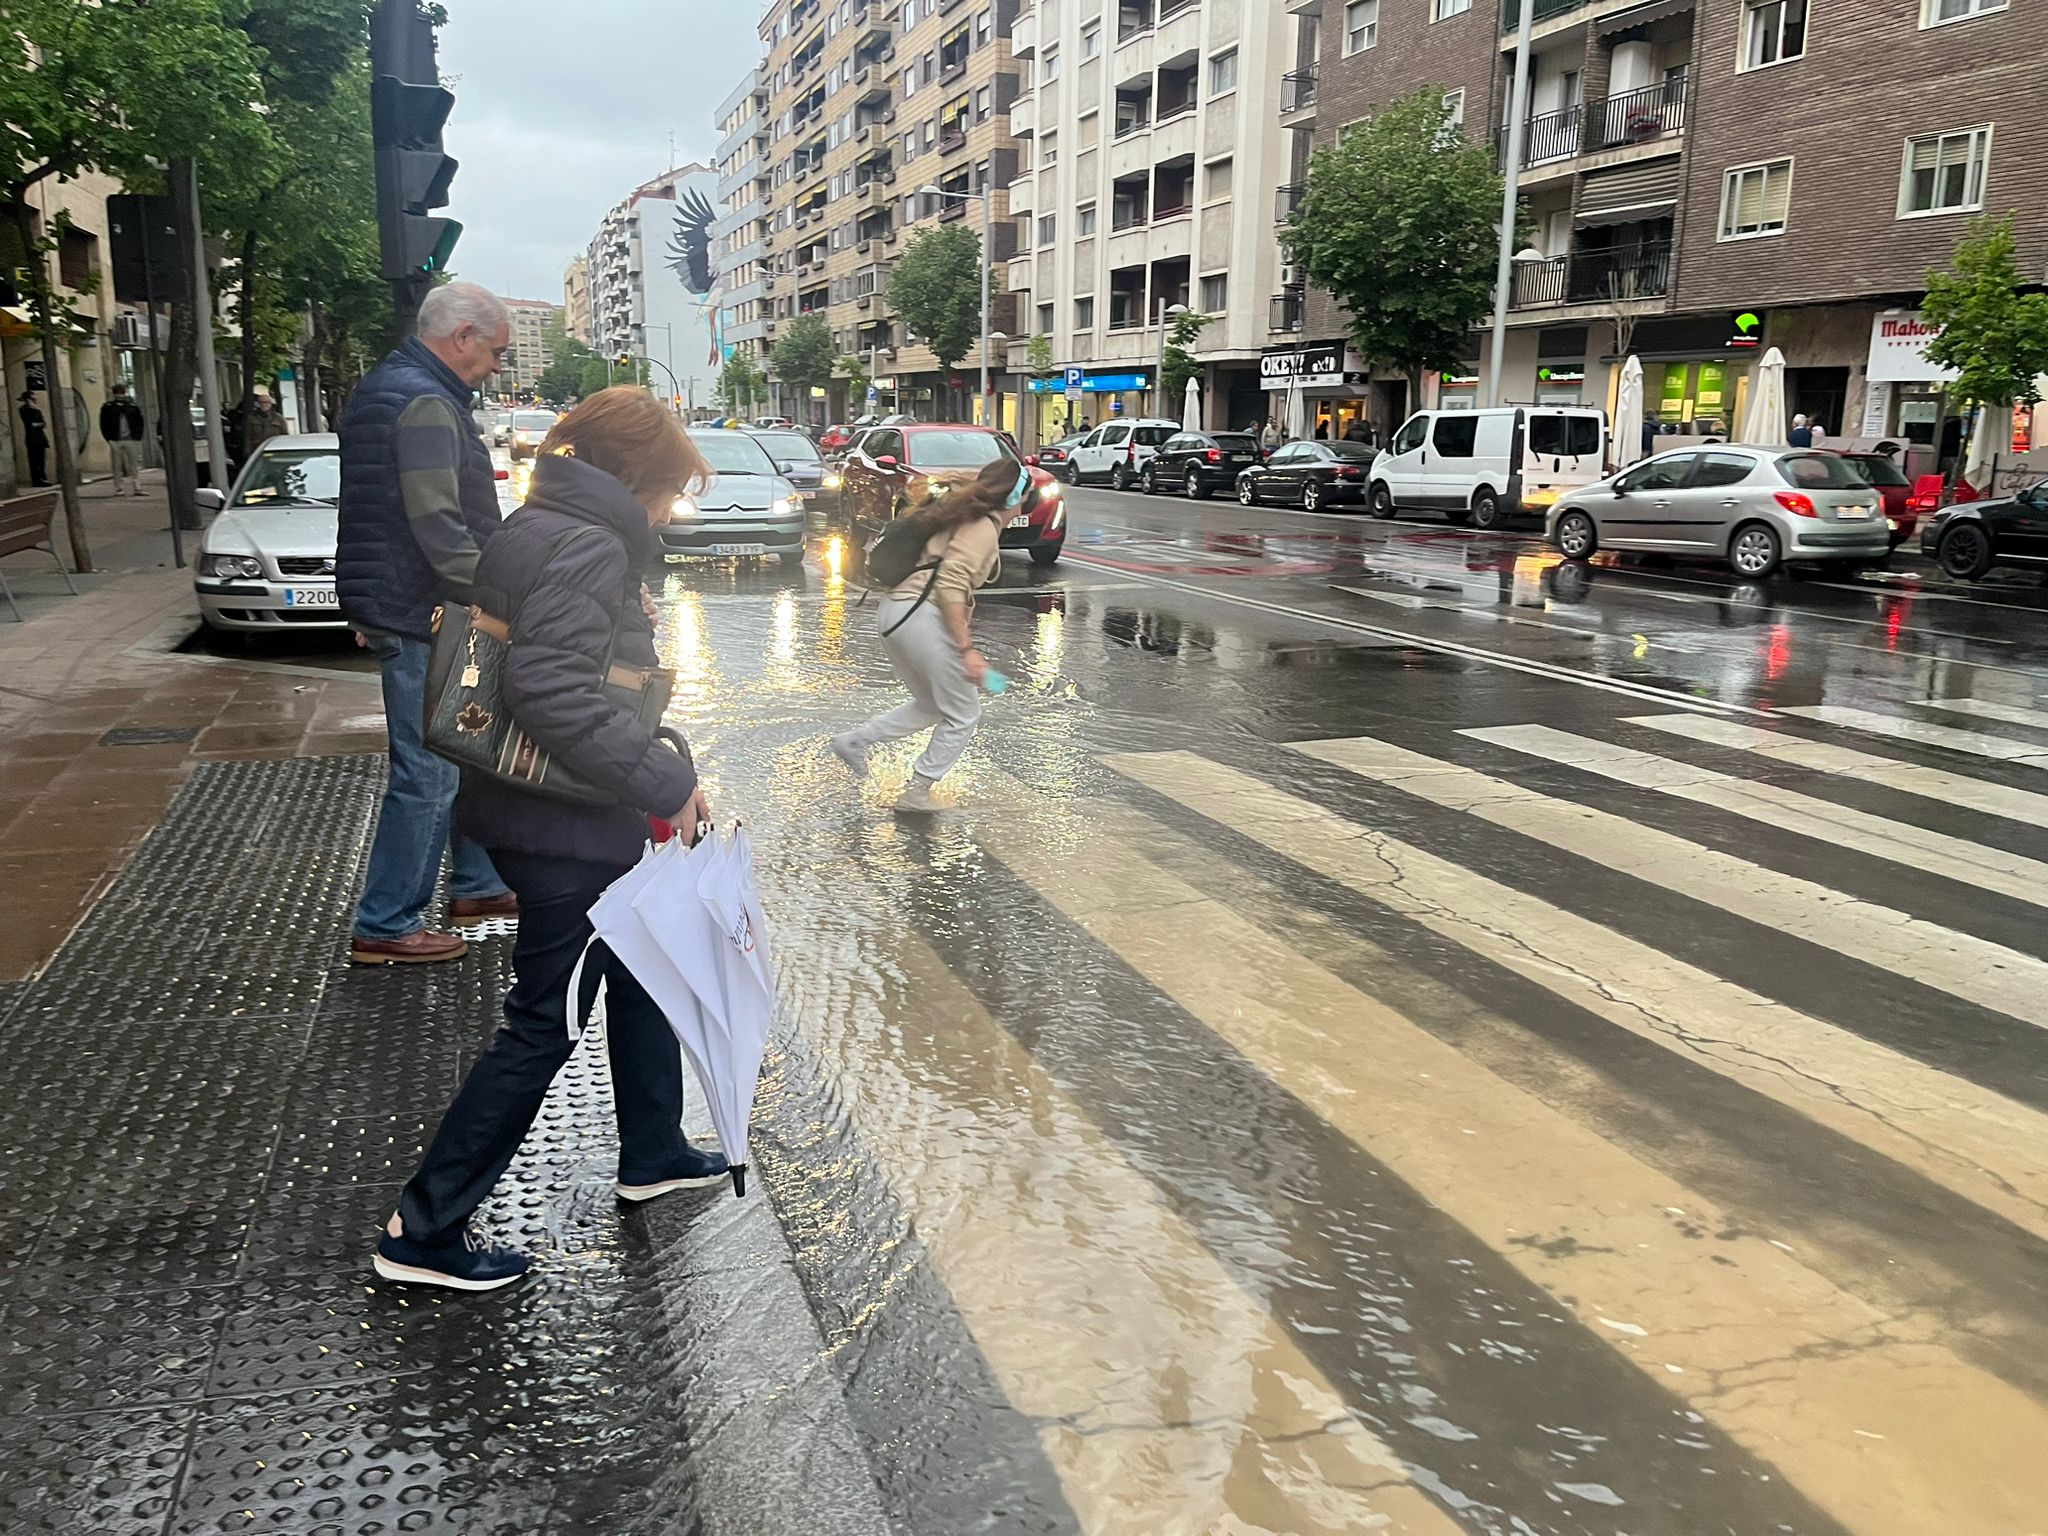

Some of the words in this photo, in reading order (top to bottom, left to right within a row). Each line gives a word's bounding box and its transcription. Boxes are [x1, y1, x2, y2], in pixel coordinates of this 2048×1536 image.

[1067, 369, 1080, 384] P
[867, 386, 876, 399] P
[296, 591, 337, 604] 2200
